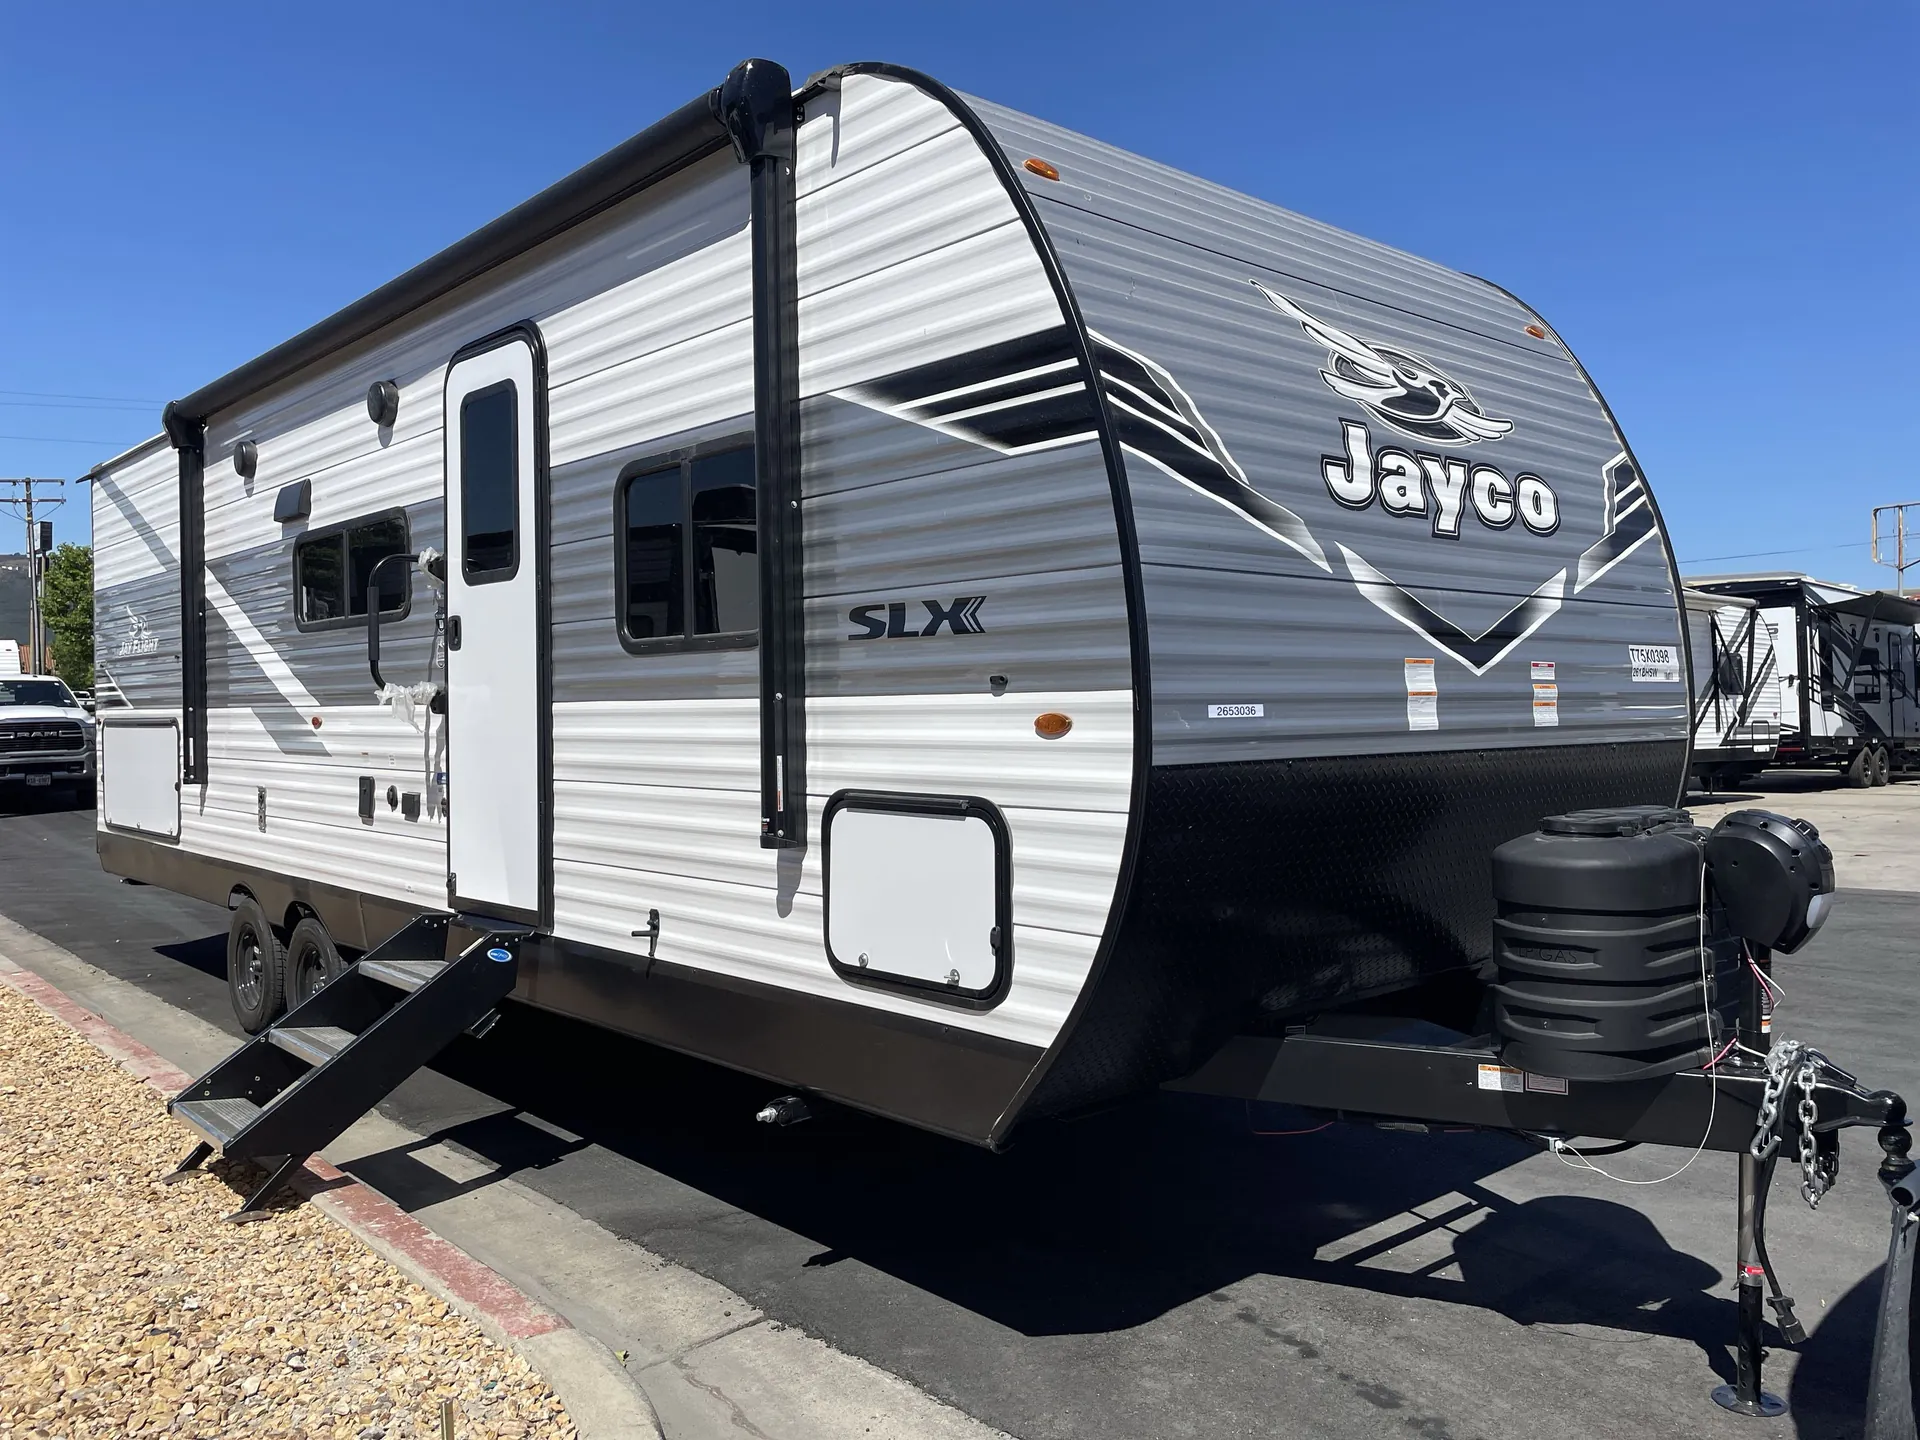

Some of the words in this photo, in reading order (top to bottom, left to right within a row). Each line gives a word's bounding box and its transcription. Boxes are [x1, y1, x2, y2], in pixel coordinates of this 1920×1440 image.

[1321, 417, 1561, 540] Jayco
[848, 596, 987, 640] SLX
[1216, 706, 1256, 716] 2653036
[1539, 948, 1579, 964] GAS
